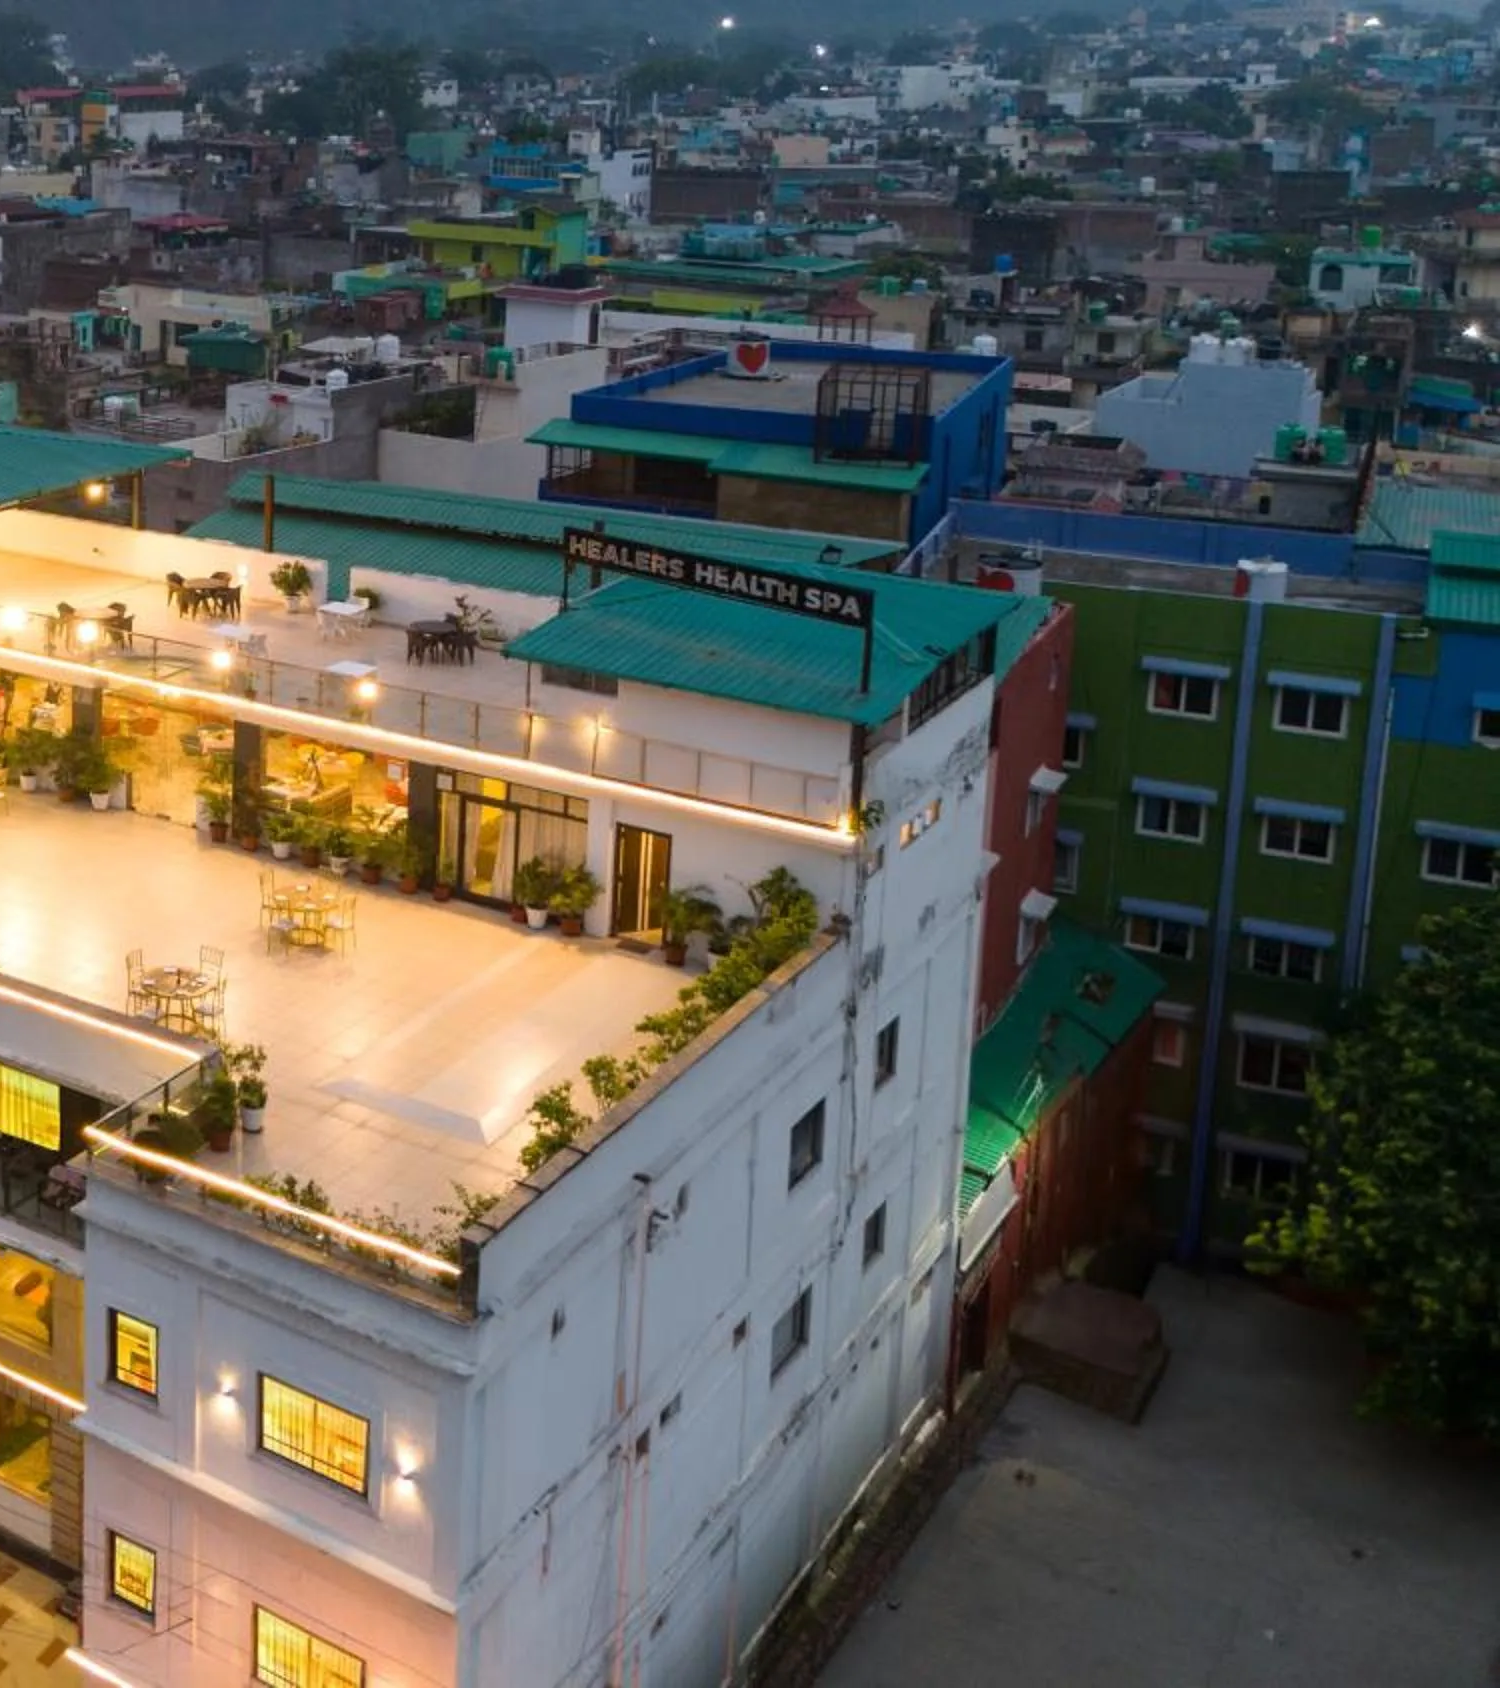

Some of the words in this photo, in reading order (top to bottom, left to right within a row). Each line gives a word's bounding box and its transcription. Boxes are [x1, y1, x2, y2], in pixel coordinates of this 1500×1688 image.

[568, 535, 685, 579] HEALERS
[695, 562, 798, 605] HEALTH
[804, 587, 861, 619] SPA
